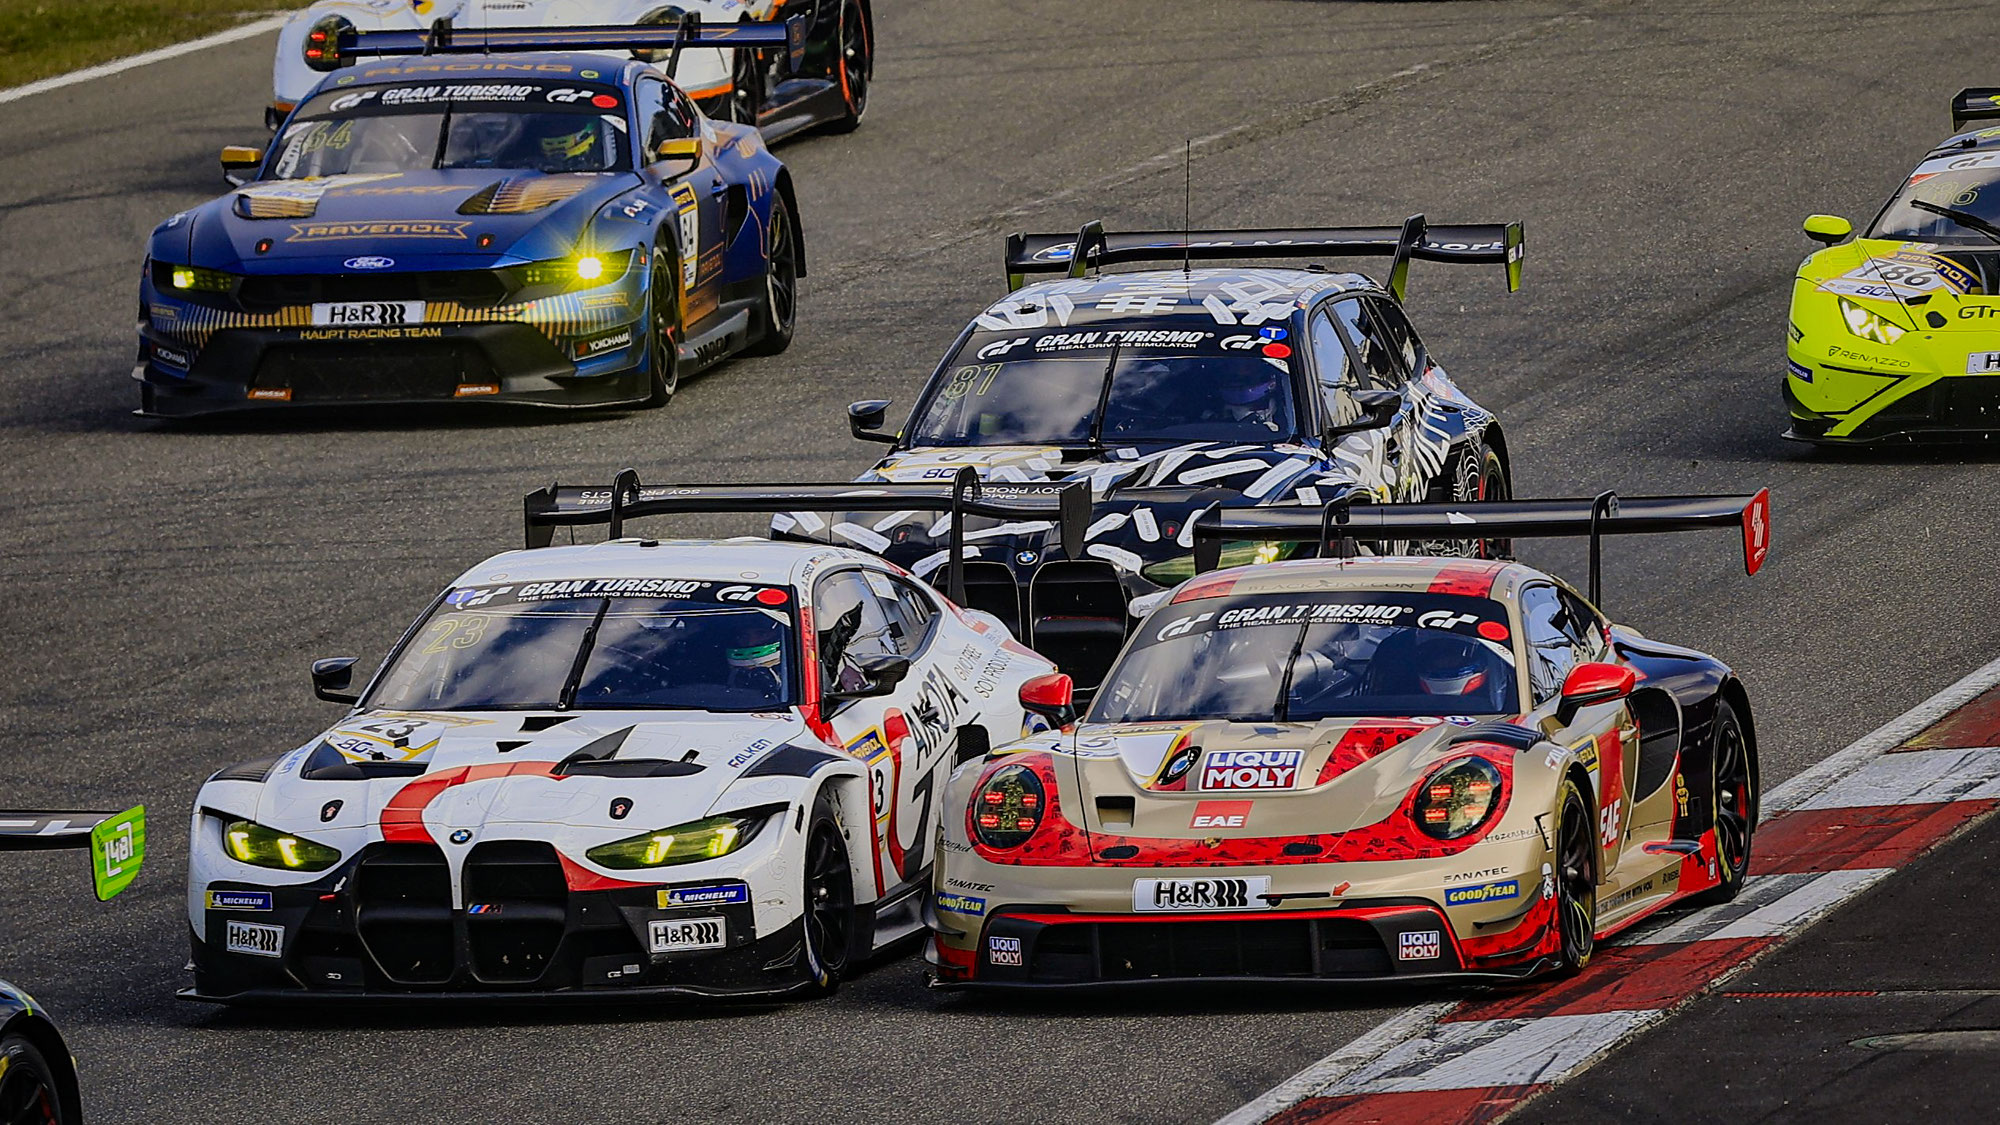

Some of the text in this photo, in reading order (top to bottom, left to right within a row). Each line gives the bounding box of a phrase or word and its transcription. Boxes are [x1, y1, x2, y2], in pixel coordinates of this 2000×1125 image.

[382, 86, 440, 100] GRAN
[303, 120, 354, 152] 64
[308, 224, 449, 237] RAVENOL
[1857, 259, 1936, 286] 786
[1897, 254, 1971, 288] RAVENOL
[330, 305, 377, 323] H&R
[300, 327, 442, 340] HAUPT RACING TEAM
[589, 332, 630, 351] YOKOHAMA
[1035, 332, 1101, 347] GRAN
[1266, 328, 1282, 339] T
[1840, 351, 1910, 367] RENAZZO
[945, 363, 1003, 398] 81
[518, 581, 591, 596] GRAN
[623, 591, 690, 599] SIMULATOR
[1218, 606, 1291, 624] GRAN
[421, 614, 490, 655] 23
[974, 675, 997, 699] SOY
[361, 719, 430, 738] 23
[727, 738, 773, 769] FALKEN
[1210, 752, 1297, 767] LIQUI
[1206, 768, 1295, 788] MOLY
[1193, 815, 1245, 827] EAE
[1600, 798, 1621, 847] EAE
[1444, 866, 1509, 882] FANATEC
[945, 878, 995, 892] FANATEC
[222, 896, 264, 905] MICHELIN
[684, 889, 738, 902] MICHELIN
[1155, 881, 1213, 907] H&R
[229, 925, 258, 947] H&R
[654, 926, 696, 945] H&R
[1402, 933, 1437, 946] LIQUI
[991, 938, 1019, 952] LIQUI
[1402, 946, 1438, 959] MOLY
[992, 952, 1021, 965] MOLY
